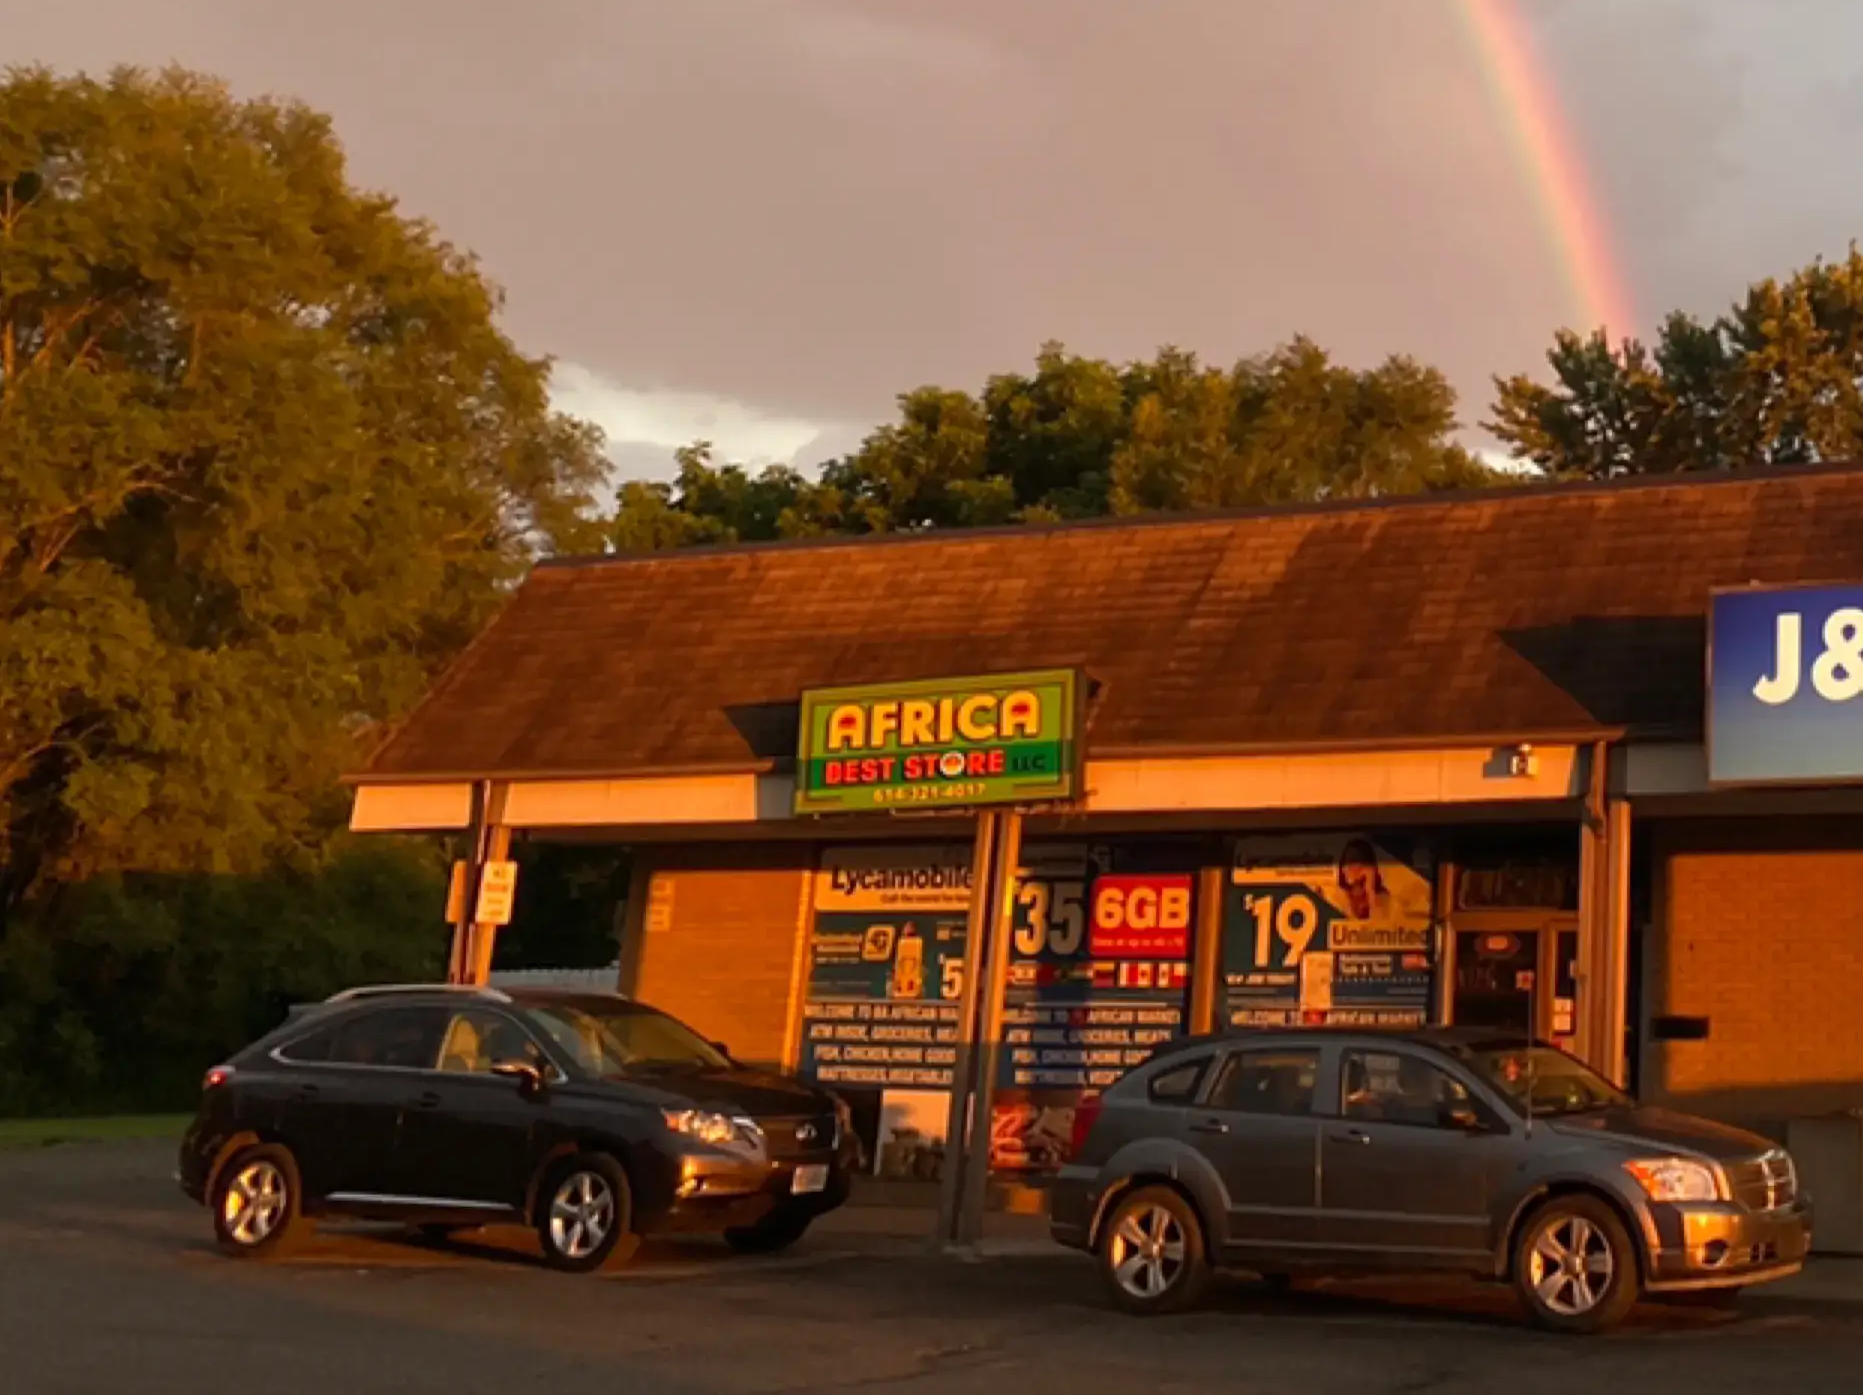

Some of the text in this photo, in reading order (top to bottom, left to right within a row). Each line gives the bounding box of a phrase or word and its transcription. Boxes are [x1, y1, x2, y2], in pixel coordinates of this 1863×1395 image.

[828, 690, 1040, 750] AFRICA
[825, 757, 896, 785] BEST
[904, 750, 1005, 778] STORE
[1095, 887, 1189, 930] 6GB
[1087, 1009, 1133, 1025] AFRICAN
